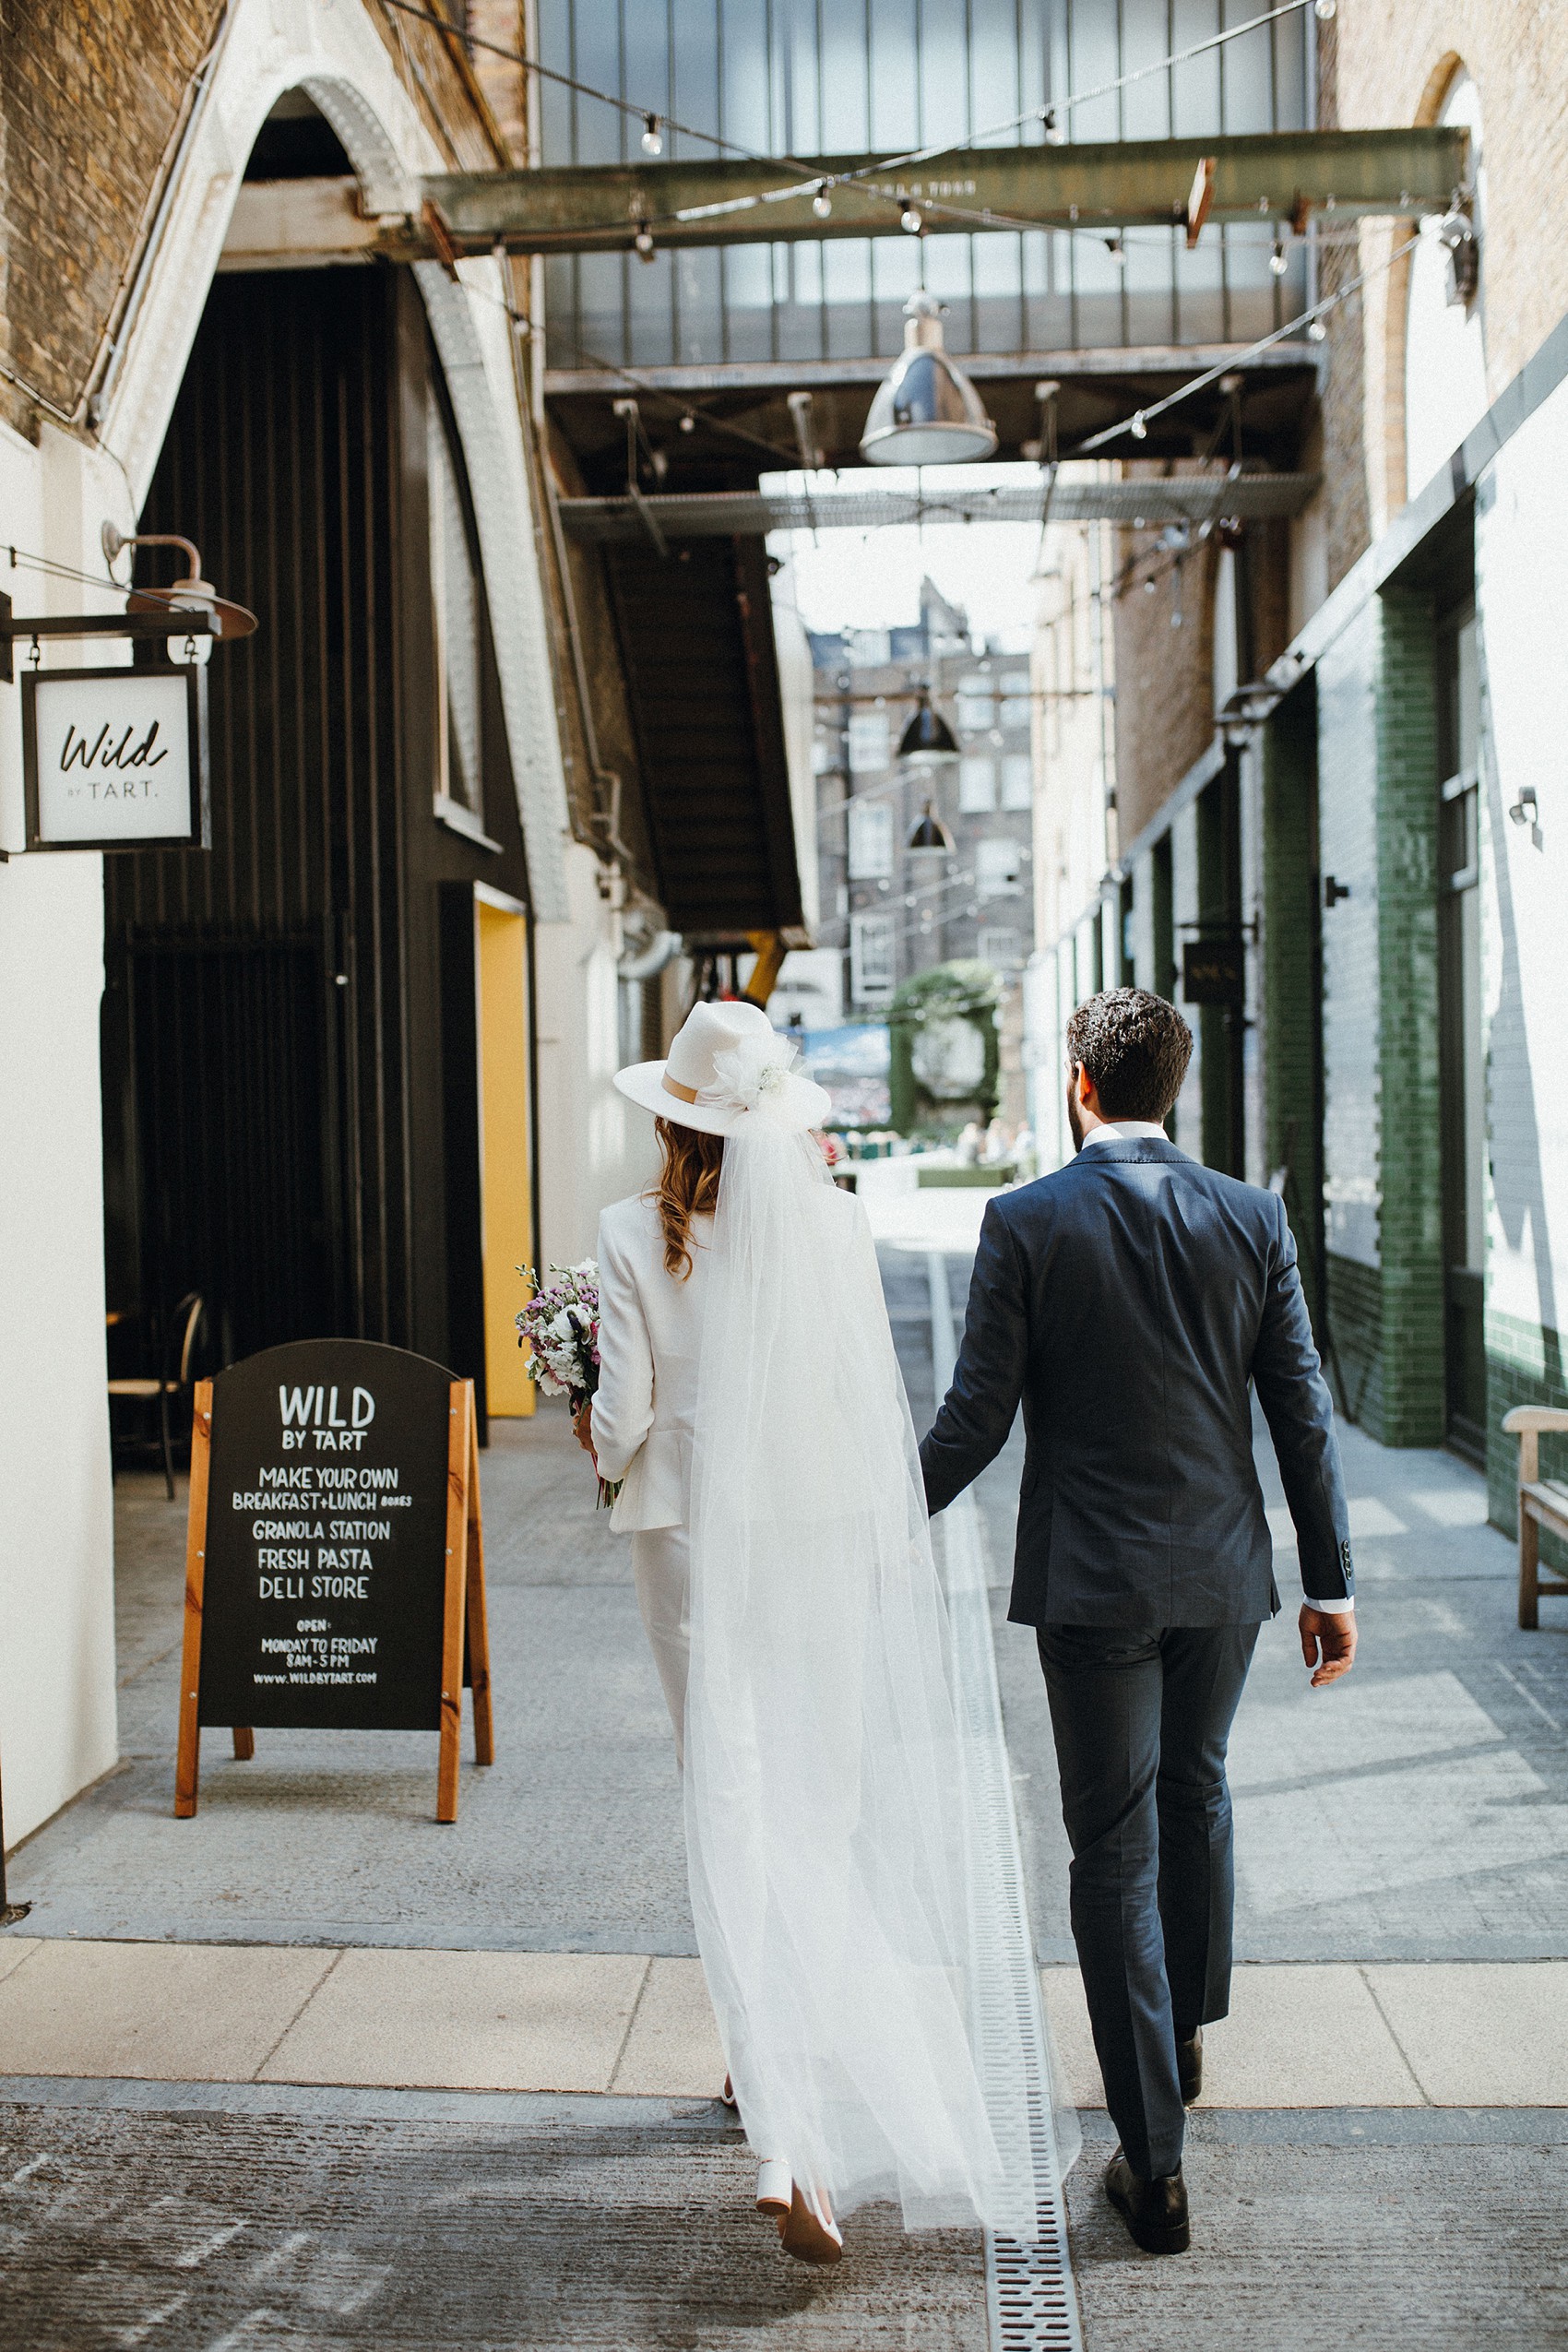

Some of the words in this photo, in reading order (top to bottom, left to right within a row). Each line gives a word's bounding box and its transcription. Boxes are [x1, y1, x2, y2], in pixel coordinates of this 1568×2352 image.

[61, 720, 168, 772] Wild
[279, 1384, 375, 1429] WILD
[281, 1430, 307, 1450] BY
[312, 1430, 368, 1452] TART
[258, 1467, 314, 1489] MAKE
[315, 1467, 357, 1490] YOUR
[359, 1467, 398, 1490] OWN
[381, 1495, 412, 1508] BOXES
[252, 1519, 325, 1540] GRANOLA
[329, 1521, 391, 1540] STATION
[257, 1548, 310, 1570] FRESH
[317, 1548, 374, 1571] PASTA
[259, 1575, 304, 1599] DELI
[311, 1575, 370, 1599] STORE
[261, 1637, 309, 1654] MONDAY
[310, 1638, 328, 1654] TO
[330, 1637, 378, 1655] FRIDAY
